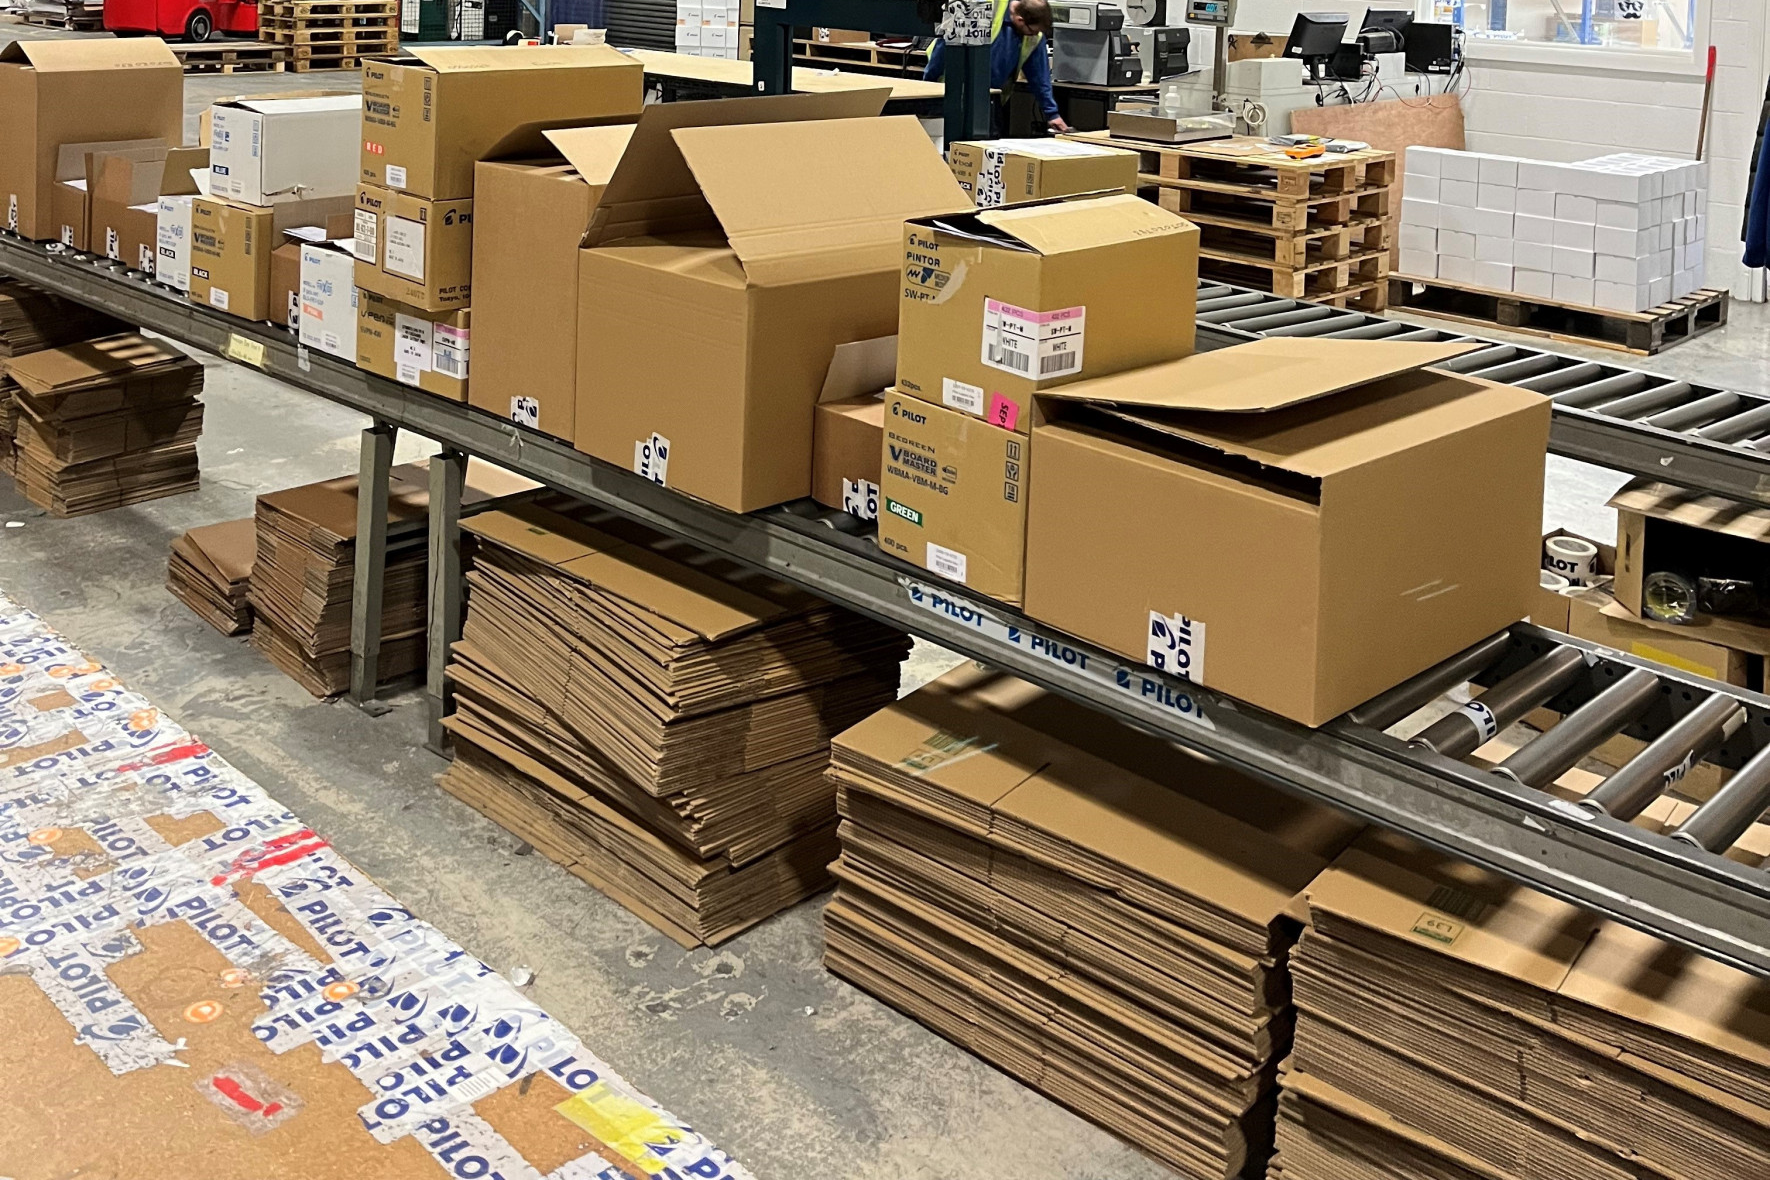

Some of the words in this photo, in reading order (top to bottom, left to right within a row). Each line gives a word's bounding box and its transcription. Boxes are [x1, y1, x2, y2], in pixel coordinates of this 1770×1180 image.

[965, 29, 991, 39] PILOT
[370, 71, 384, 80] PILOT
[366, 141, 383, 155] RED
[366, 197, 382, 209] PILOT
[160, 248, 175, 258] BLACK
[917, 239, 940, 251] PILOT
[906, 251, 941, 267] PINTOR
[193, 268, 208, 278] BLACK
[439, 287, 456, 295] PILOT
[1003, 336, 1018, 350] WHITE
[1052, 341, 1067, 352] WHITE
[902, 409, 926, 425] PILOT
[889, 445, 903, 462] V
[902, 449, 937, 468] BOARD
[902, 458, 937, 477] MASTER
[890, 501, 919, 524] GREEN
[931, 593, 983, 627] PILOT
[1030, 634, 1091, 671] PILOT
[13, 739, 116, 778] PILOT
[177, 895, 263, 953] PILOT
[297, 899, 373, 960] PILOT
[46, 951, 121, 1015] PILOT
